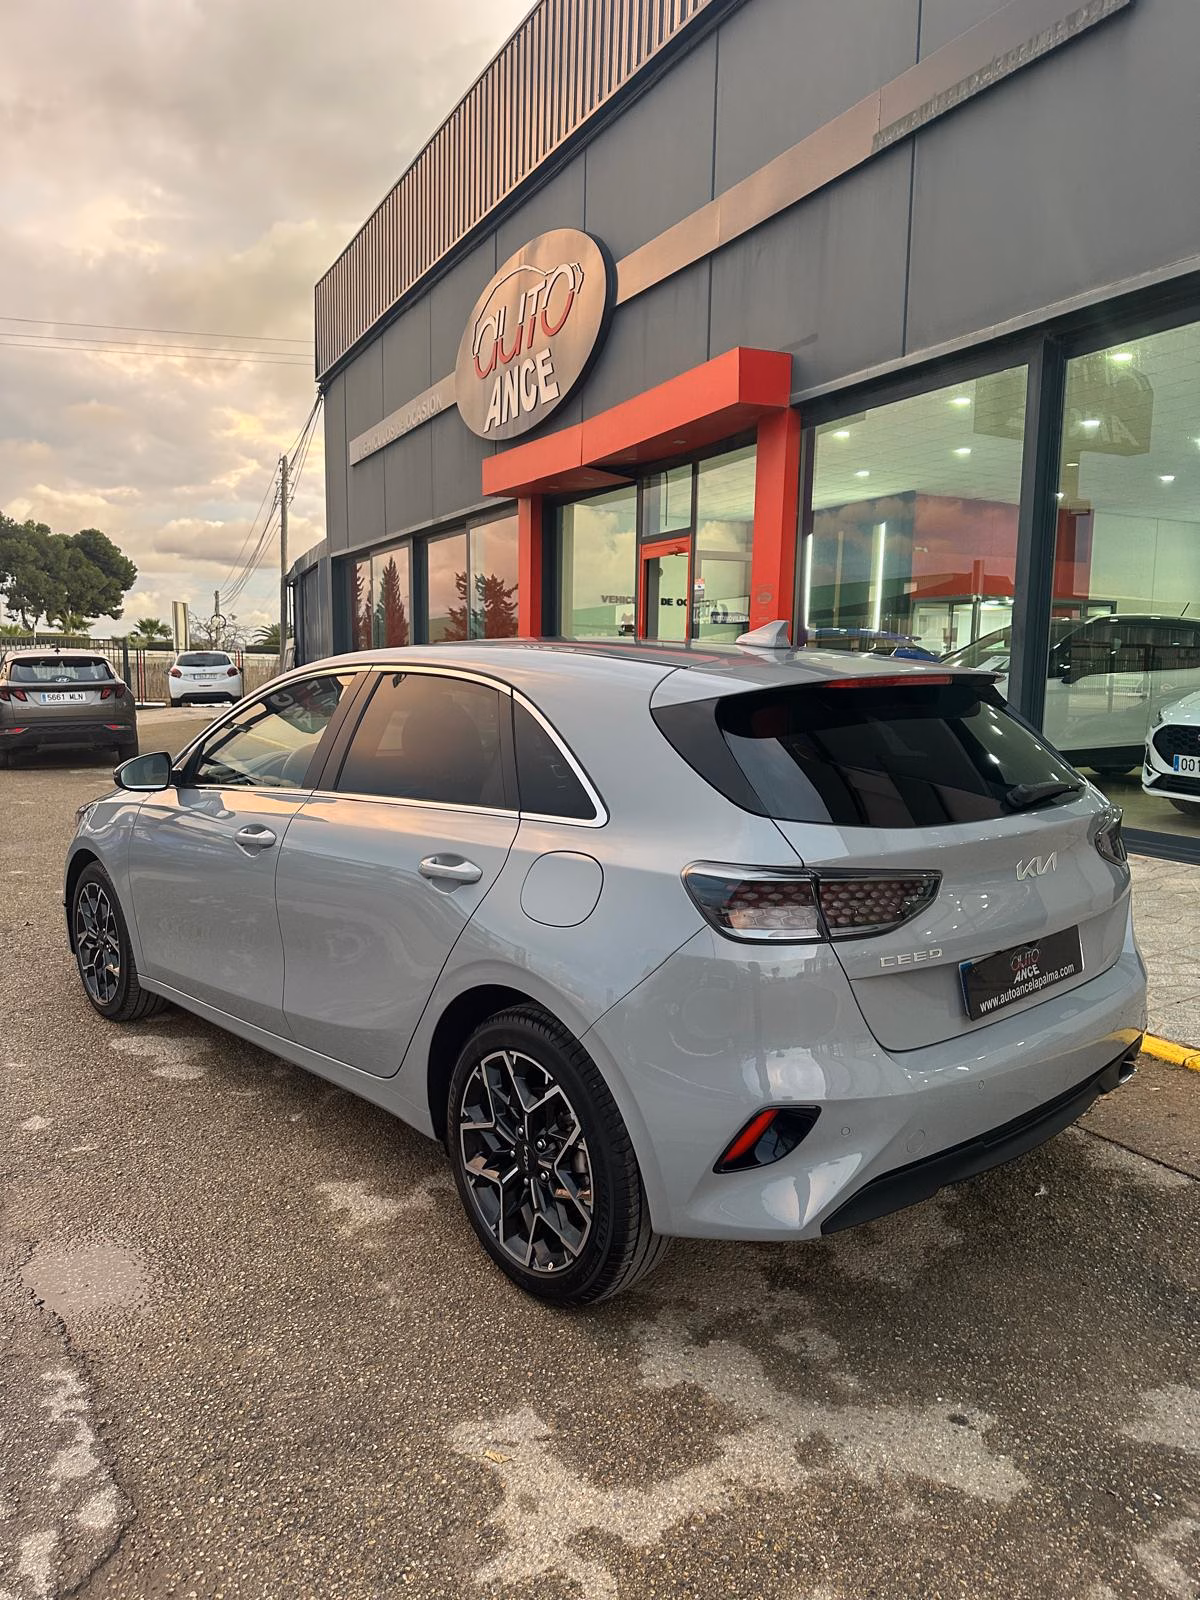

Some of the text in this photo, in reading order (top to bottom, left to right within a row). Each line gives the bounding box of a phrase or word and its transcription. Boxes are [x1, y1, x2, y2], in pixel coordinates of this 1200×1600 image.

[474, 264, 576, 379] AUTO
[484, 348, 560, 433] ANCE
[660, 597, 674, 606] DE
[47, 691, 84, 703] 5661 MLN
[1015, 849, 1058, 881] KIA
[879, 948, 943, 968] CEED
[1010, 947, 1041, 972] AUTO
[1013, 965, 1041, 984] ANCE
[979, 961, 1075, 1014] www.autoancelapalma.com
